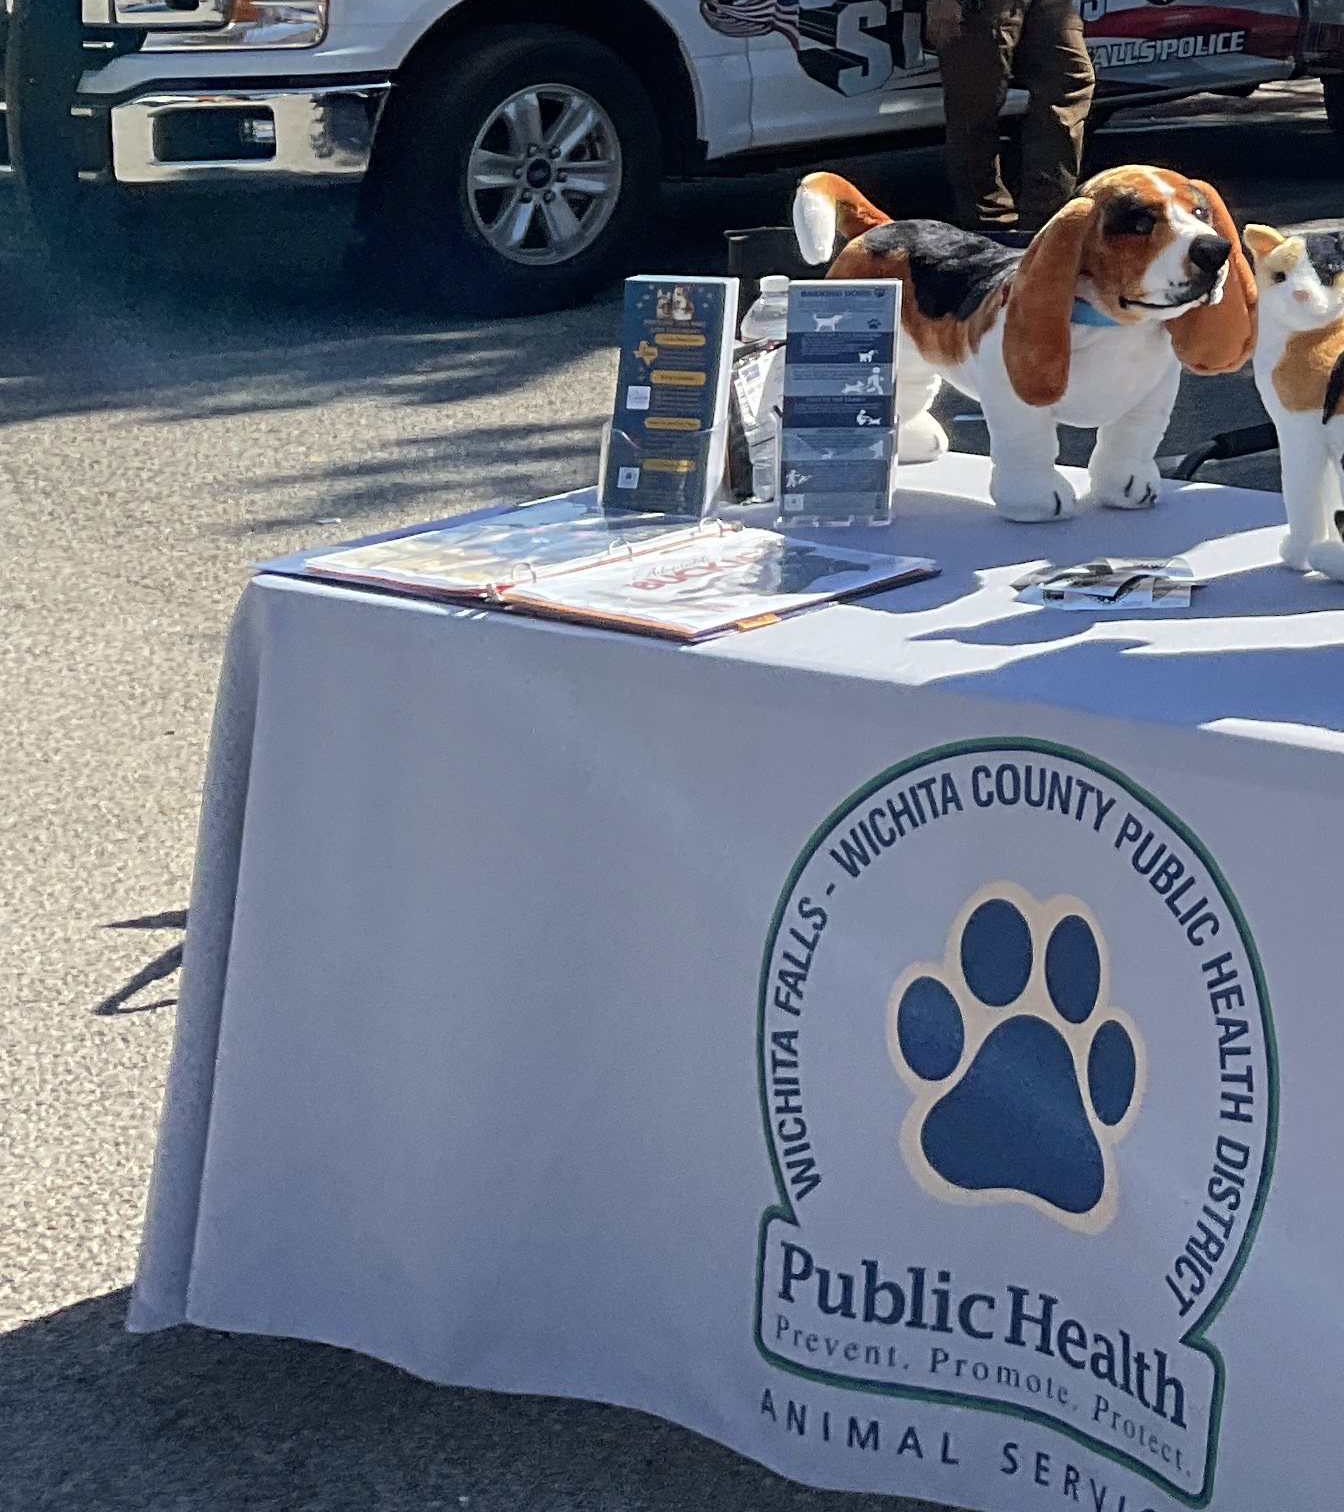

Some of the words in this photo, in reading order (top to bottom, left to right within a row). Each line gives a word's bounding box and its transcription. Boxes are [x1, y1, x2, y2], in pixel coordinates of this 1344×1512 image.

[1092, 40, 1157, 68] ALLS
[829, 773, 963, 878] WICHITA
[972, 764, 1116, 832] COUNTY
[1114, 812, 1220, 947] PUBLIC
[775, 896, 828, 1016] FALLS
[1201, 951, 1254, 1123] HEALTH
[771, 1030, 822, 1201] WICHITA
[1165, 1135, 1250, 1317] DISTRICT
[761, 1388, 958, 1464] ANIMAL
[1001, 1442, 1156, 1512] SERVI
[777, 1314, 909, 1371] Prevent.
[930, 1346, 1078, 1411] Promote.
[1092, 1394, 1191, 1478] Protect.
